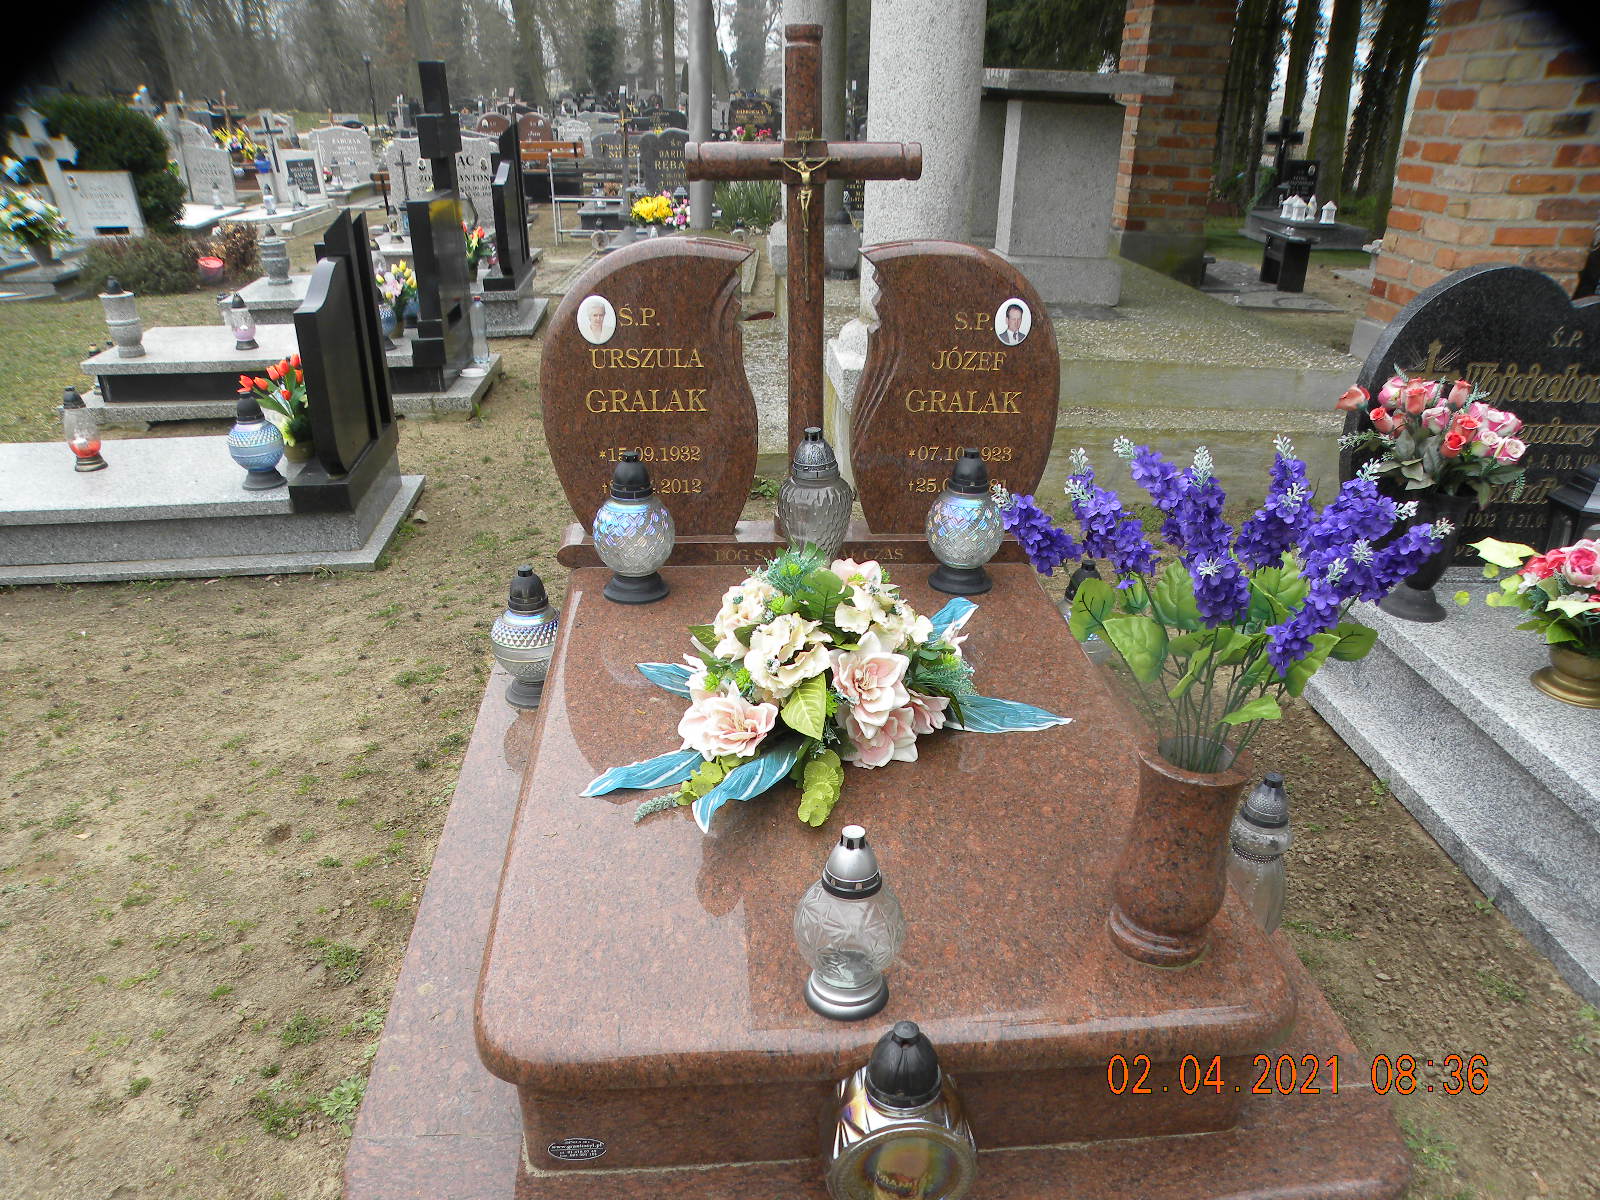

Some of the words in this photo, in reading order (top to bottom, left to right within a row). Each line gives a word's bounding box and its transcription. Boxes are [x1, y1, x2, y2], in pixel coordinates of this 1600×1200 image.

[588, 347, 705, 369] URSZULA
[931, 345, 1008, 372] JÓZEF
[585, 388, 708, 414] GRALAK
[905, 388, 1023, 415] GRALAK
